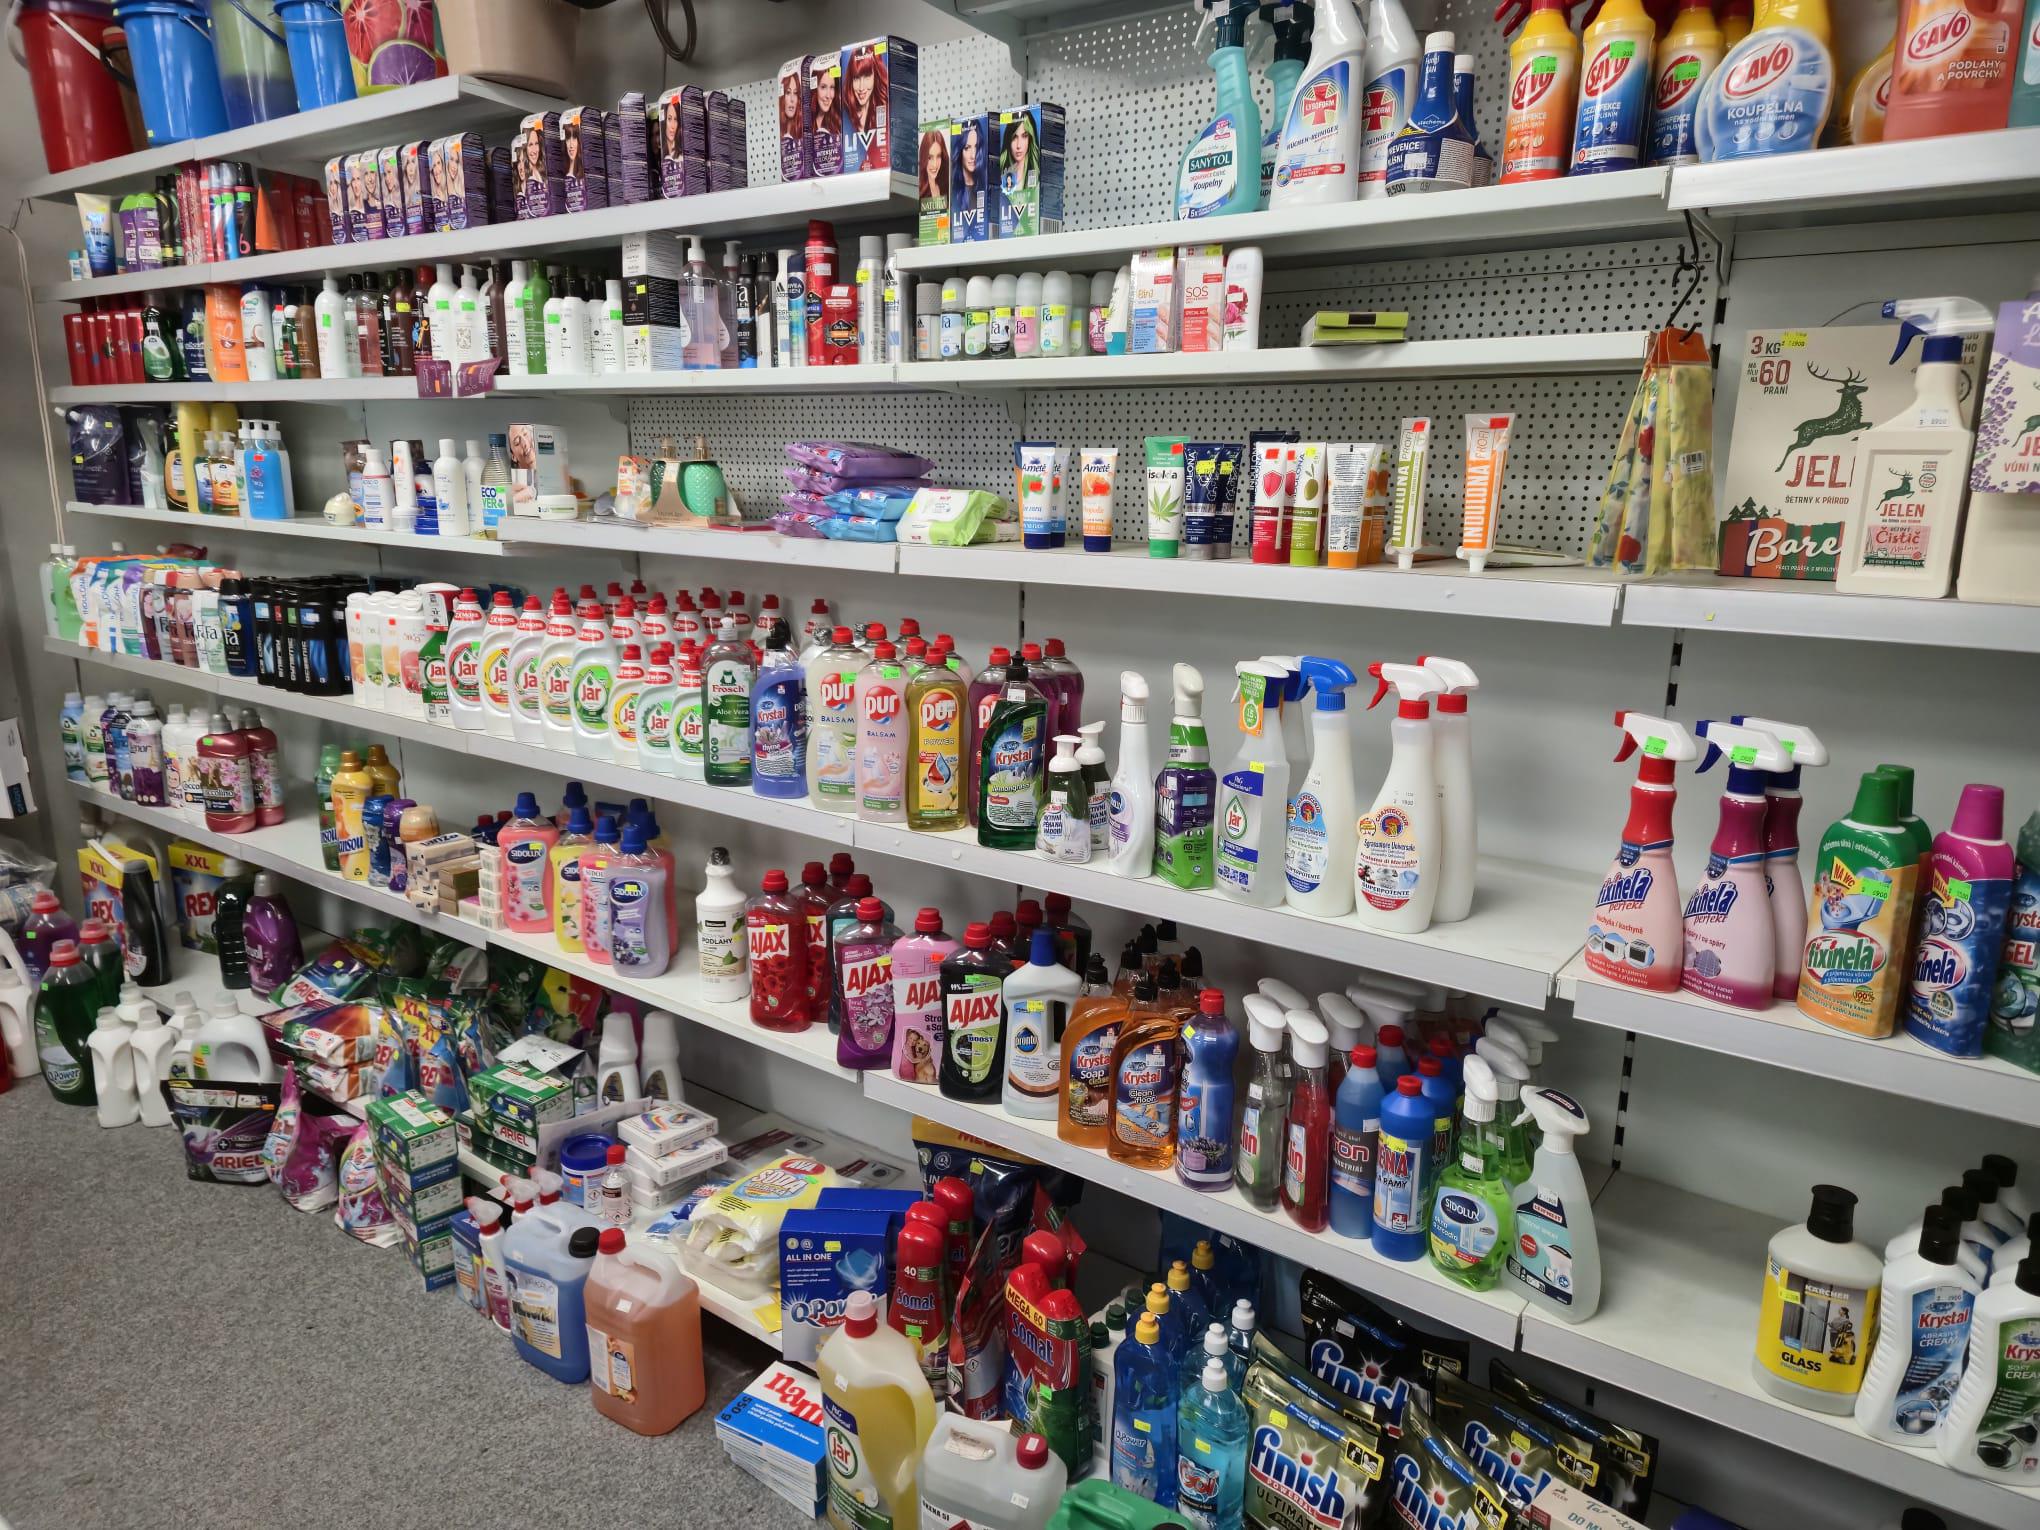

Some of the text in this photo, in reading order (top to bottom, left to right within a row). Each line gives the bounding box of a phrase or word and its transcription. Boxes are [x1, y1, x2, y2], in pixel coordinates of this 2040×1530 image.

[1915, 10, 1967, 53] SAVO
[1949, 60, 2000, 69] PODLAHY
[1937, 69, 2000, 81] A POVRCHY
[1305, 99, 1335, 111] LYSOFORM
[1727, 101, 1803, 120] KOUPELNA
[844, 127, 887, 153] LIVE
[1190, 155, 1230, 171] SANYTOL
[953, 208, 984, 226] LIVE
[1001, 202, 1036, 219] LIVE
[1186, 286, 1209, 298] SOS
[1015, 320, 1027, 334] Fa
[1751, 336, 1781, 355] 3 KG
[1759, 359, 1791, 386] 60
[1764, 386, 1789, 395] PRANÍ
[1402, 430, 1413, 460] PROFI
[1476, 430, 1489, 459] PROFI
[1185, 450, 1197, 501] INDULONA
[2004, 462, 2030, 474] VŮNI
[481, 487, 497, 498] ECO
[1392, 464, 1410, 542] INDULONA
[1463, 463, 1490, 543] INDULONA
[1880, 503, 1925, 517] JELEN
[1876, 527, 1921, 544] Čistič
[1746, 527, 1842, 567] Bare
[206, 626, 217, 640] Fa
[224, 630, 239, 646] Fa
[458, 660, 478, 677] Jar
[549, 679, 570, 693] Jar
[582, 684, 602, 701] Jar
[712, 684, 745, 693] Frosch
[821, 683, 855, 707] pur
[865, 695, 899, 720] pur
[651, 716, 669, 731] Jar
[758, 709, 786, 723] Krystal
[821, 715, 855, 724] BALSAM
[683, 720, 703, 736] Jar
[867, 730, 897, 738] BALSAM
[762, 742, 781, 752] thyme
[996, 750, 1032, 766] Krystal
[1228, 811, 1242, 828] Jar
[511, 849, 542, 858] SIDOLUX
[89, 859, 107, 878] XXL
[184, 854, 210, 870] XXL
[1833, 862, 1855, 889] NA WC
[614, 887, 643, 898] SIDOLUX
[1362, 883, 1409, 897] SUPERPOTENTE
[91, 901, 115, 923] REX
[185, 892, 217, 918] REX
[1609, 901, 1645, 914] perfekt
[1694, 914, 1727, 926] perfekt
[702, 936, 733, 945] PODLAHY
[751, 927, 787, 955] AJAX
[1807, 938, 1875, 971] fixinela
[2004, 942, 2034, 967] GEL
[848, 963, 893, 994] AJAX
[906, 979, 942, 1010] AJA
[950, 993, 1000, 1028] AJAX
[968, 1034, 993, 1043] BOOST
[1014, 1035, 1039, 1047] pronto
[1081, 1070, 1104, 1080] Soap
[1122, 1069, 1162, 1085] Krystal
[1129, 1089, 1154, 1097] Clean
[1134, 1096, 1156, 1104] floor
[500, 1126, 529, 1147] ARIEL
[212, 1155, 264, 1169] ARIEL
[788, 1159, 818, 1174] AVA
[752, 1169, 808, 1194] SODA
[1444, 1198, 1480, 1223] SIDOLUX
[1437, 1225, 1459, 1241] zrcadla
[786, 1253, 801, 1261] ALL
[802, 1253, 813, 1261] IN
[904, 1266, 917, 1277] 40
[897, 1288, 936, 1311] Somat
[1805, 1284, 1850, 1300] KÄRCHER
[1007, 1288, 1044, 1327] MEGA 60
[1918, 1309, 1968, 1329] Krystal
[1012, 1313, 1055, 1365] Somat
[1918, 1336, 1959, 1348] CREAM
[1781, 1351, 1823, 1373] GLASS
[2007, 1364, 2030, 1372] SOFT
[730, 1396, 754, 1415] 550
[832, 1436, 851, 1465] Jar
[1251, 1425, 1346, 1521] finish
[1266, 1476, 1320, 1519] POWERBALL
[1256, 1485, 1324, 1530] ULTIMATE
